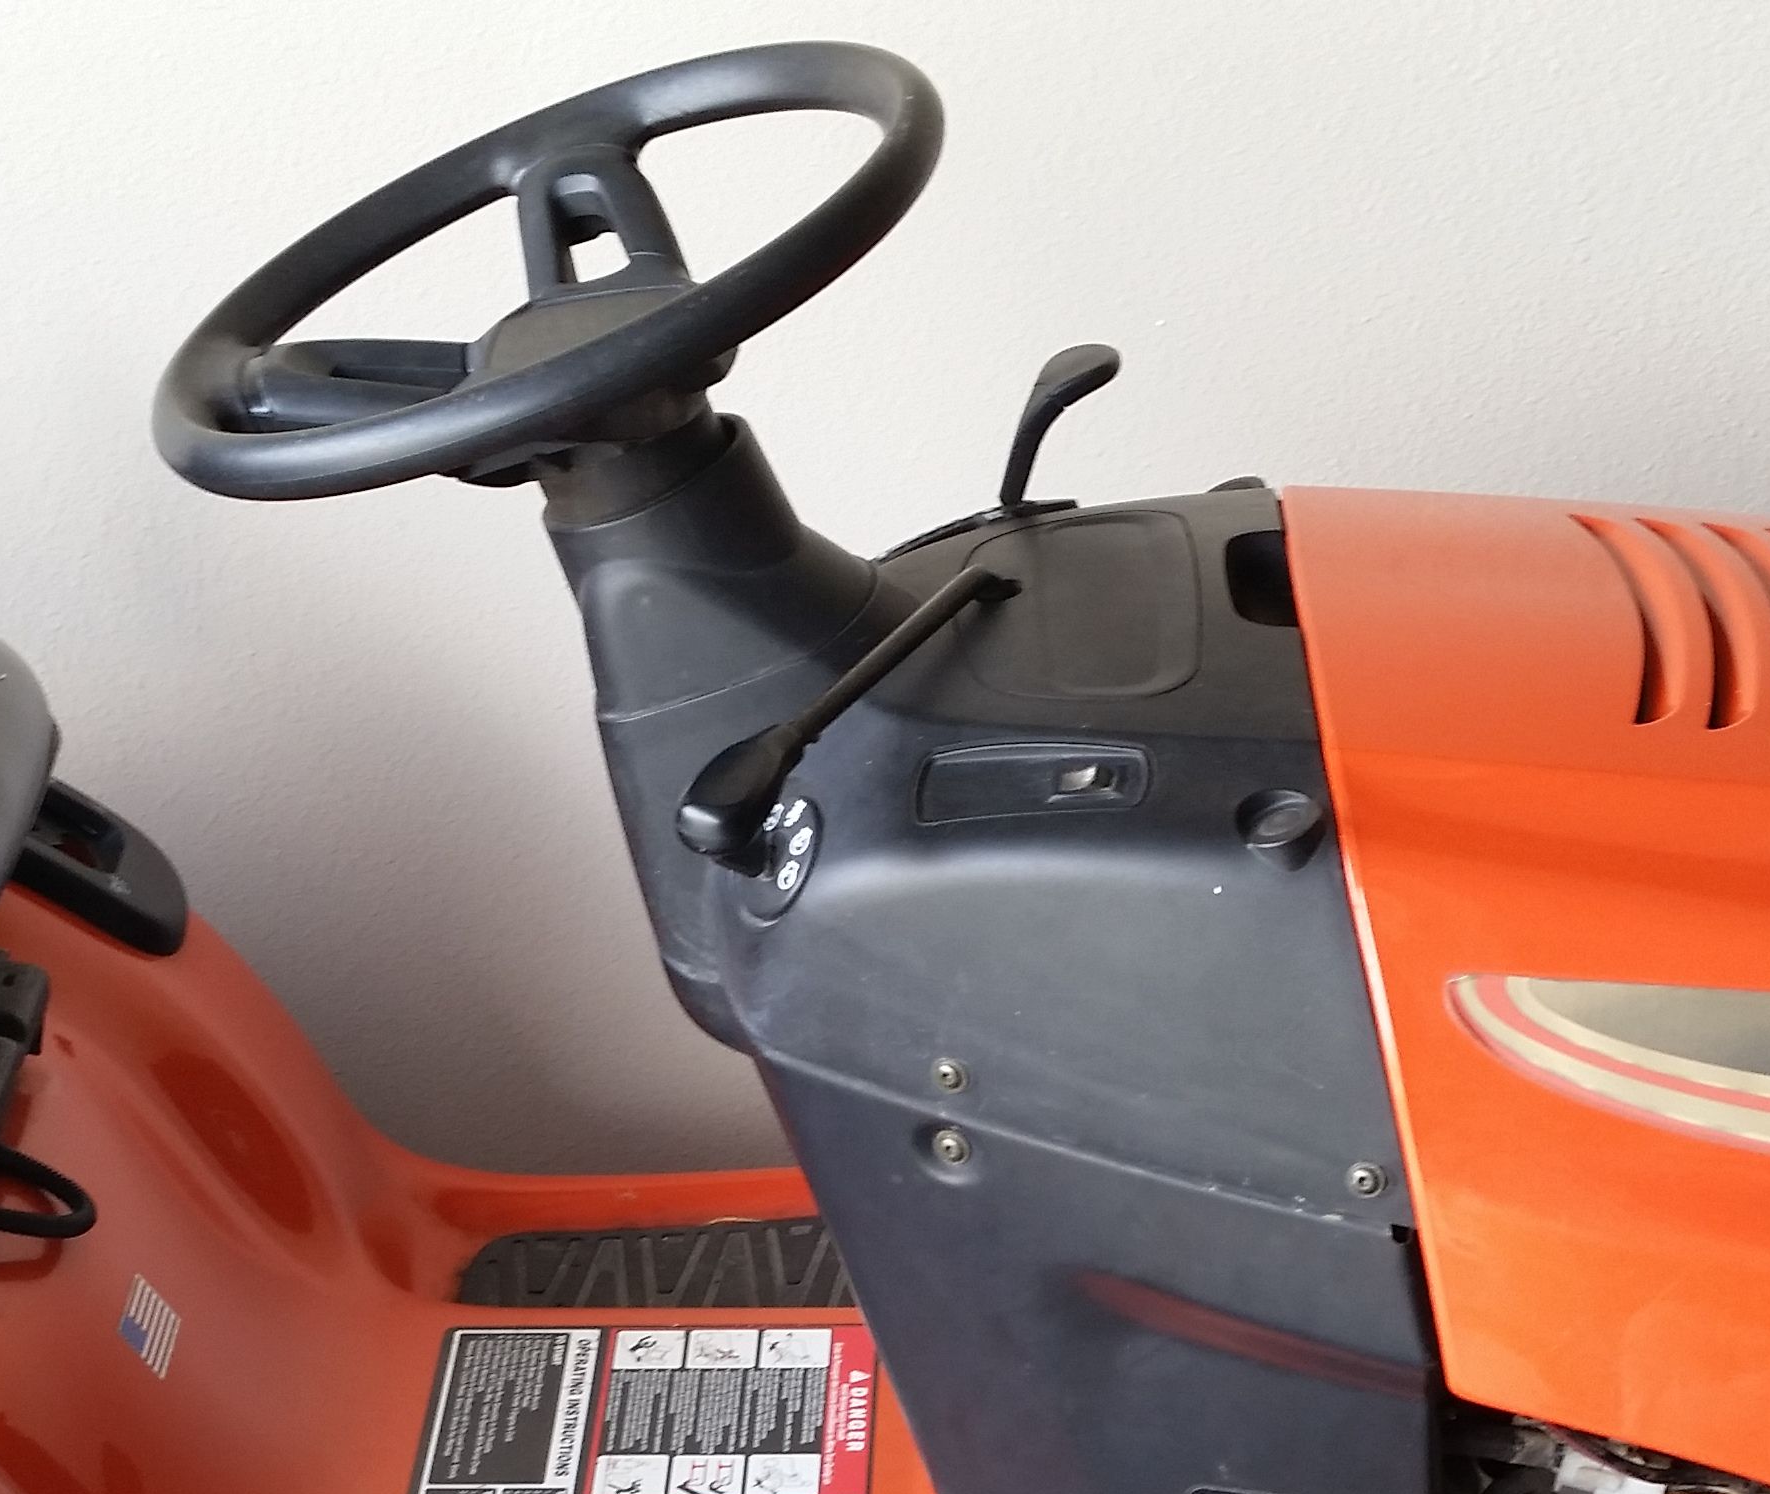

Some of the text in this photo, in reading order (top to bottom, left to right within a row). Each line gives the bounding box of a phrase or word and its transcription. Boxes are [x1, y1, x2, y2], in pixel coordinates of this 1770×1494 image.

[554, 1338, 592, 1478] OPERATING INSTRUCTIONS
[844, 1386, 870, 1452] DANGER
